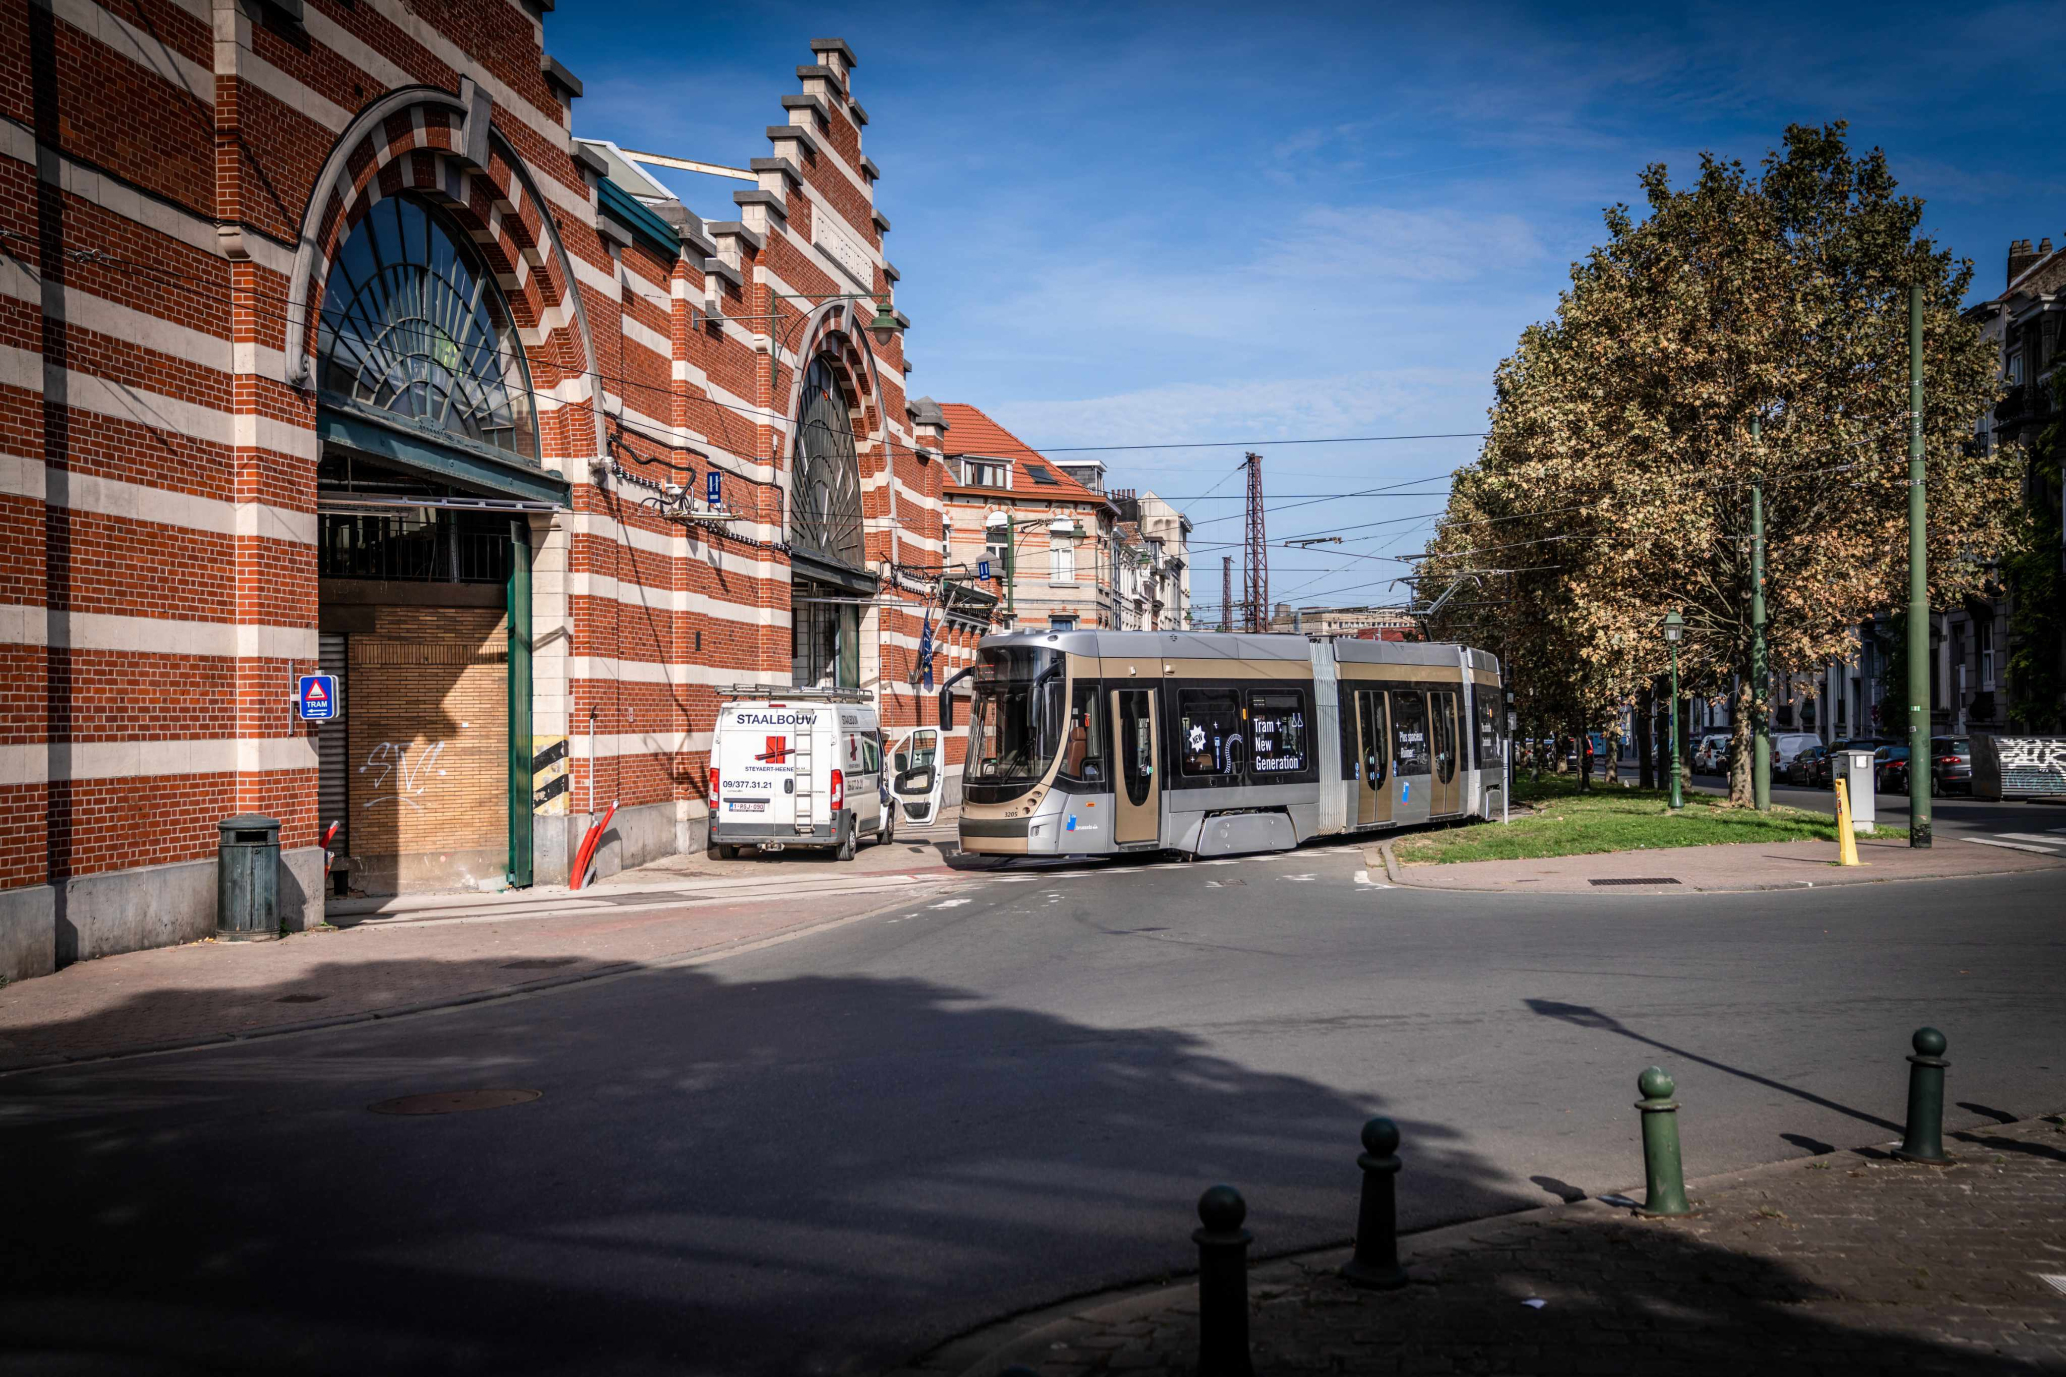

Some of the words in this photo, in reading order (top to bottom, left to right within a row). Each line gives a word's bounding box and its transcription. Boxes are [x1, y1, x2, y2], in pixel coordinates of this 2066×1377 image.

[736, 714, 818, 725] STAALBOUW
[1253, 718, 1274, 733] Tram
[1191, 732, 1203, 745] NEW
[1255, 737, 1272, 752] New
[1256, 755, 1299, 771] Generation
[722, 780, 772, 789] 09/377.31.21
